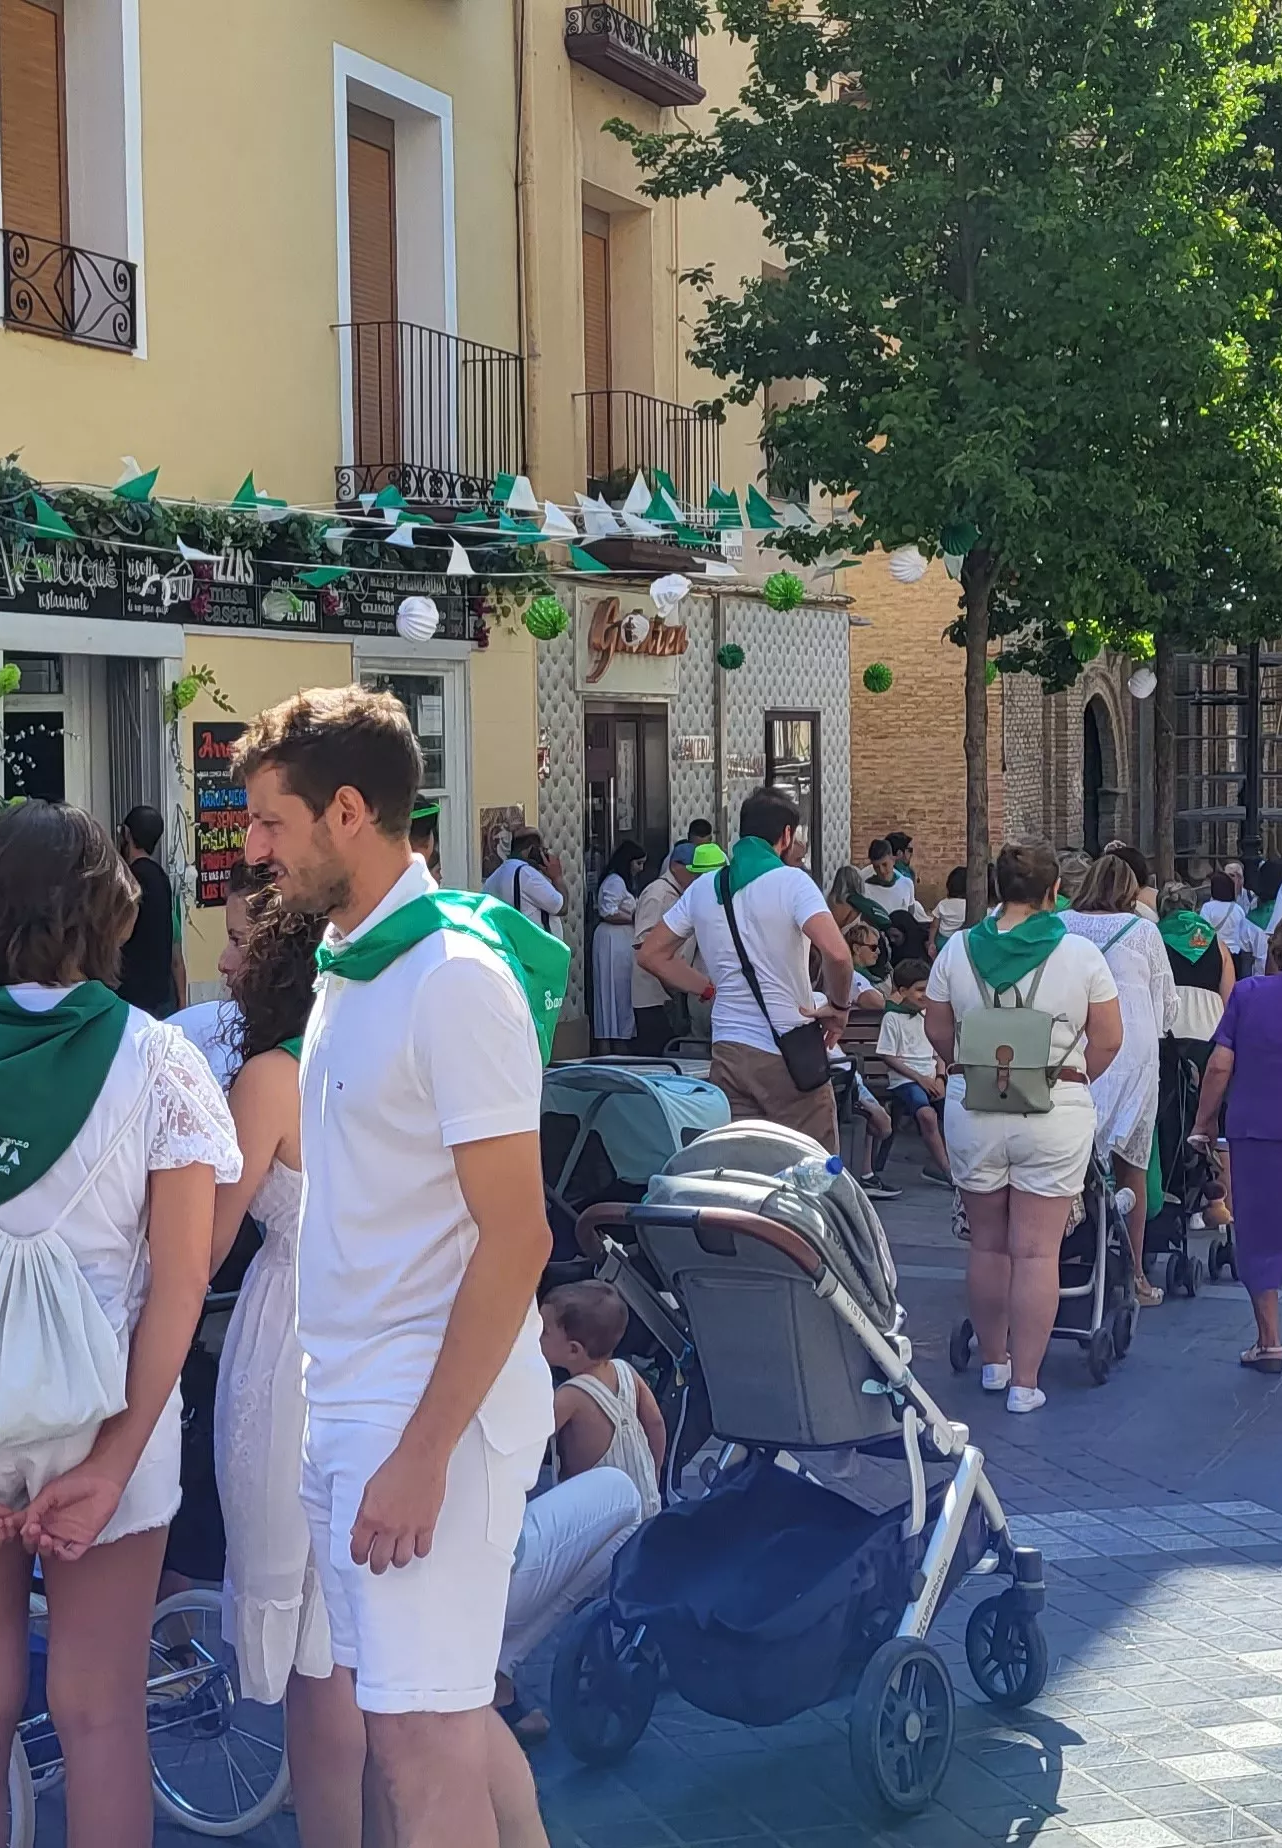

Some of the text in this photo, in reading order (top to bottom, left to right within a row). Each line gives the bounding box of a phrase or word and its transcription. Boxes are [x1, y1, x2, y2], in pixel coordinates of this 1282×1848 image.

[211, 549, 255, 585] IZZAS
[37, 591, 90, 612] restaurante
[209, 585, 248, 606] masa
[204, 604, 256, 625] casera
[845, 1296, 867, 1329] VISTA
